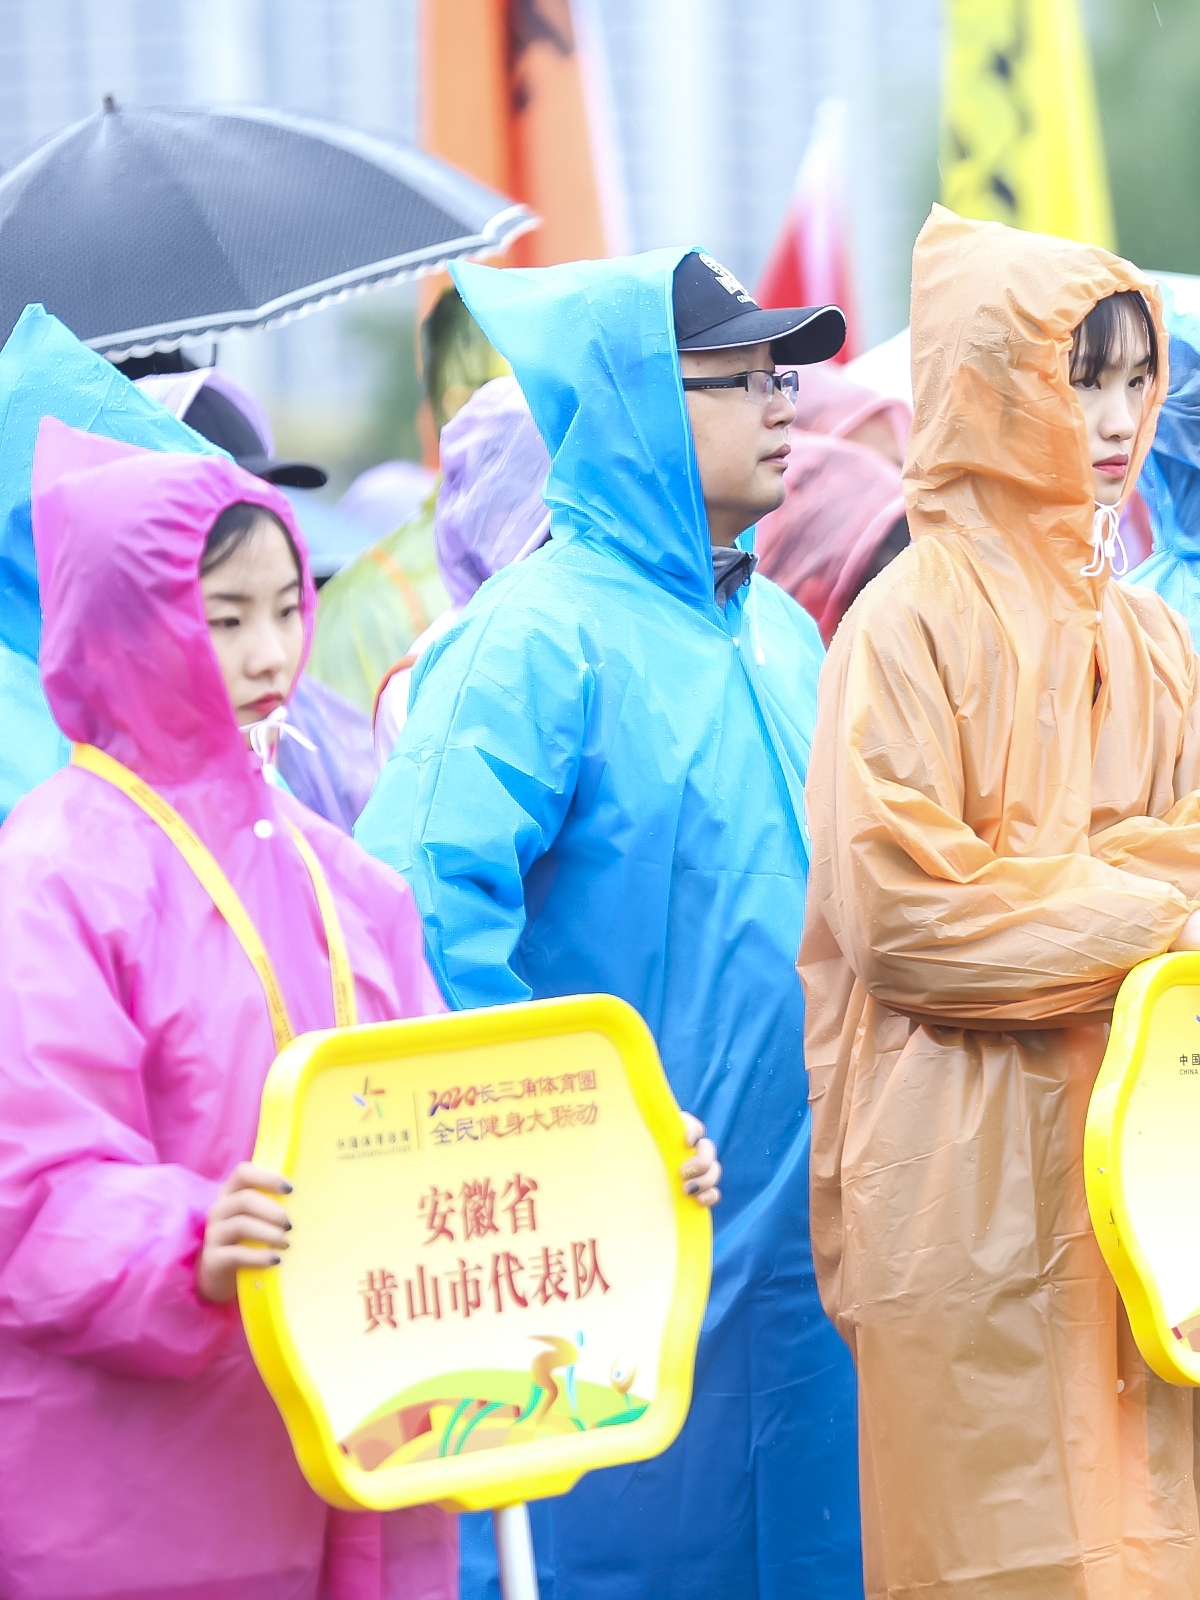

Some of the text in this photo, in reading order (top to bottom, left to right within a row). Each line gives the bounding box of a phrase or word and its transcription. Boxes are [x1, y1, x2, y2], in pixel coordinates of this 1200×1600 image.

[428, 1069, 598, 1117] 2020长三角体育圈
[1179, 1068, 1199, 1076] CHINA
[430, 1101, 599, 1145] 全民健身大联动
[418, 1172, 539, 1246] 安徽省
[357, 1238, 611, 1334] 黄山市代表队
